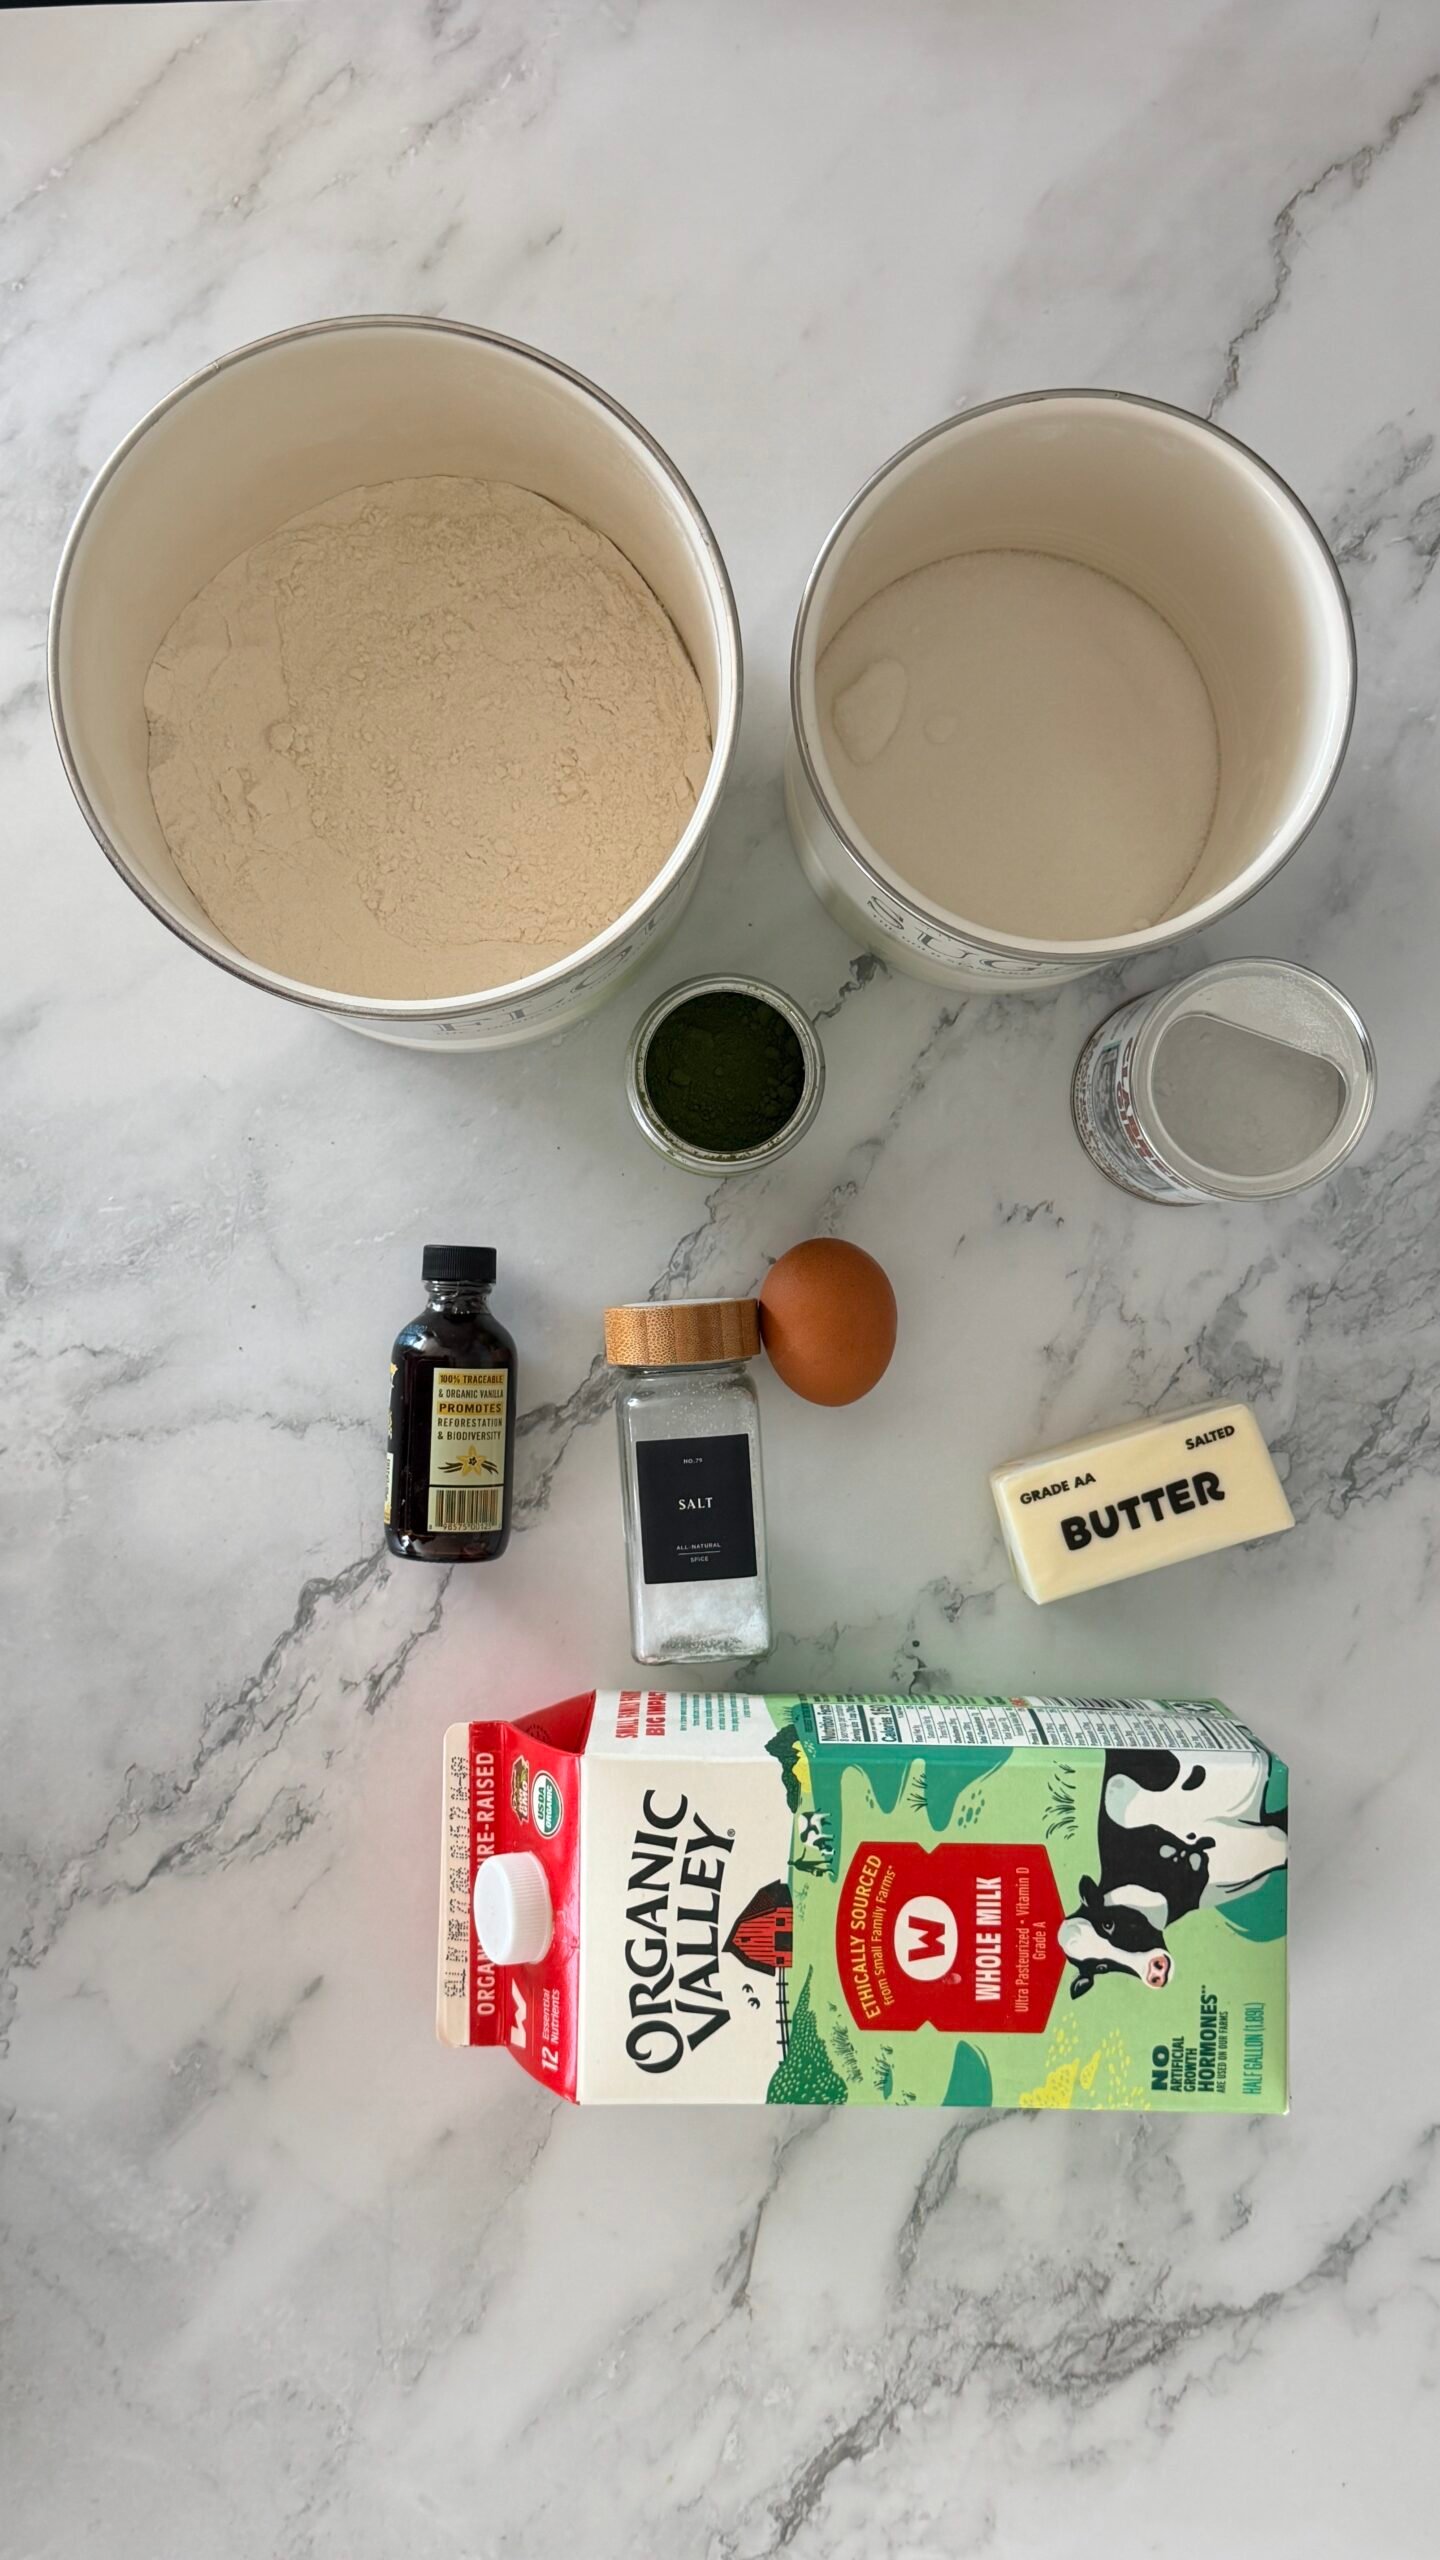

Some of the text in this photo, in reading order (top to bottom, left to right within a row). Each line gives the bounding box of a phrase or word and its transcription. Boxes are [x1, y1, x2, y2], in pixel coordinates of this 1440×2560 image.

[438, 1388, 504, 1399] & ORGANIC VANILLA
[440, 1374, 504, 1384] 100% TRACEABLE
[437, 1417, 503, 1428] REFORESTATION
[439, 1403, 502, 1413] PROMOTES
[437, 1430, 501, 1441] & BIODIVERSITY
[1184, 1424, 1236, 1451] SALTED
[678, 1497, 713, 1510] SALT
[1020, 1472, 1097, 1505] GRADE AA
[1060, 1471, 1226, 1551] BUTTER
[690, 1555, 709, 1563] SPICE
[646, 1717, 666, 1736] BIG
[878, 1717, 898, 1742] Calories
[537, 1787, 545, 1820] USDA
[545, 1784, 553, 1829] ORGANIC
[449, 1899, 471, 1914] 27
[1015, 1878, 1030, 1916] Vitamin
[624, 1789, 689, 2074] ORGANIC
[850, 1855, 883, 2020] ETHICALLY SOURCED
[871, 1906, 887, 1942] Family
[908, 1915, 945, 1962] W
[975, 1876, 1002, 2002] WHOLE MILK
[1032, 1921, 1047, 1960] Grade A
[446, 1946, 468, 1963] BY
[872, 1945, 886, 1976] Small
[1015, 1927, 1030, 1986] Pasteurized
[877, 1977, 895, 2006] from
[1015, 1989, 1030, 2013] Ultra
[551, 1988, 560, 2045] Nutrients
[541, 2046, 559, 2072] 12
[1170, 2036, 1184, 2092] ARTIFICIAL
[1216, 2011, 1228, 2093] ARE USED ON OUR FARMS
[1242, 2002, 1266, 2095] HALF GALLON (1.89L)
[1151, 2045, 1169, 2091] NO
[1184, 2048, 1197, 2092] GROWTH
